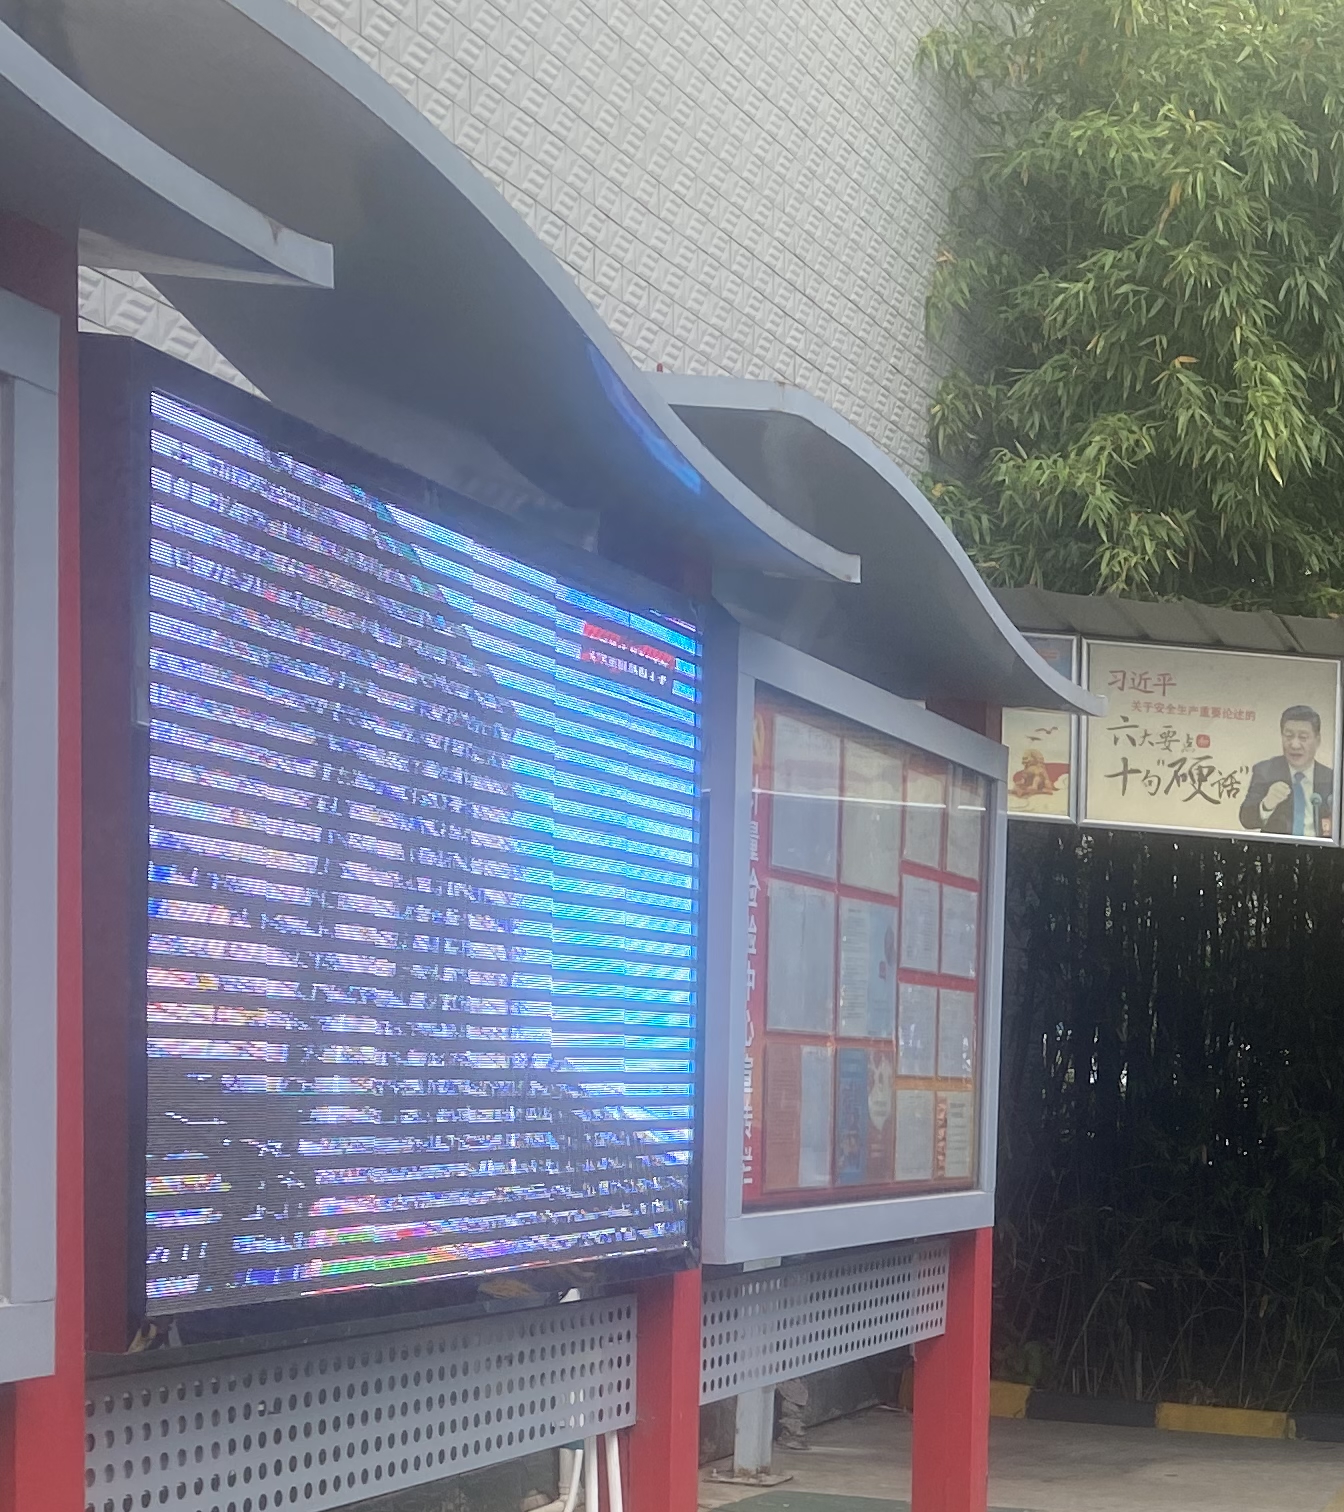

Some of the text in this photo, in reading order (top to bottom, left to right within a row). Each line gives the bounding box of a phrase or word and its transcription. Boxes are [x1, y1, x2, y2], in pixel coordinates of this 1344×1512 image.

[1108, 670, 1177, 697] 习近平
[1131, 700, 1256, 721] 关于安全生产重要论述的
[1106, 715, 1196, 753] 六大要点
